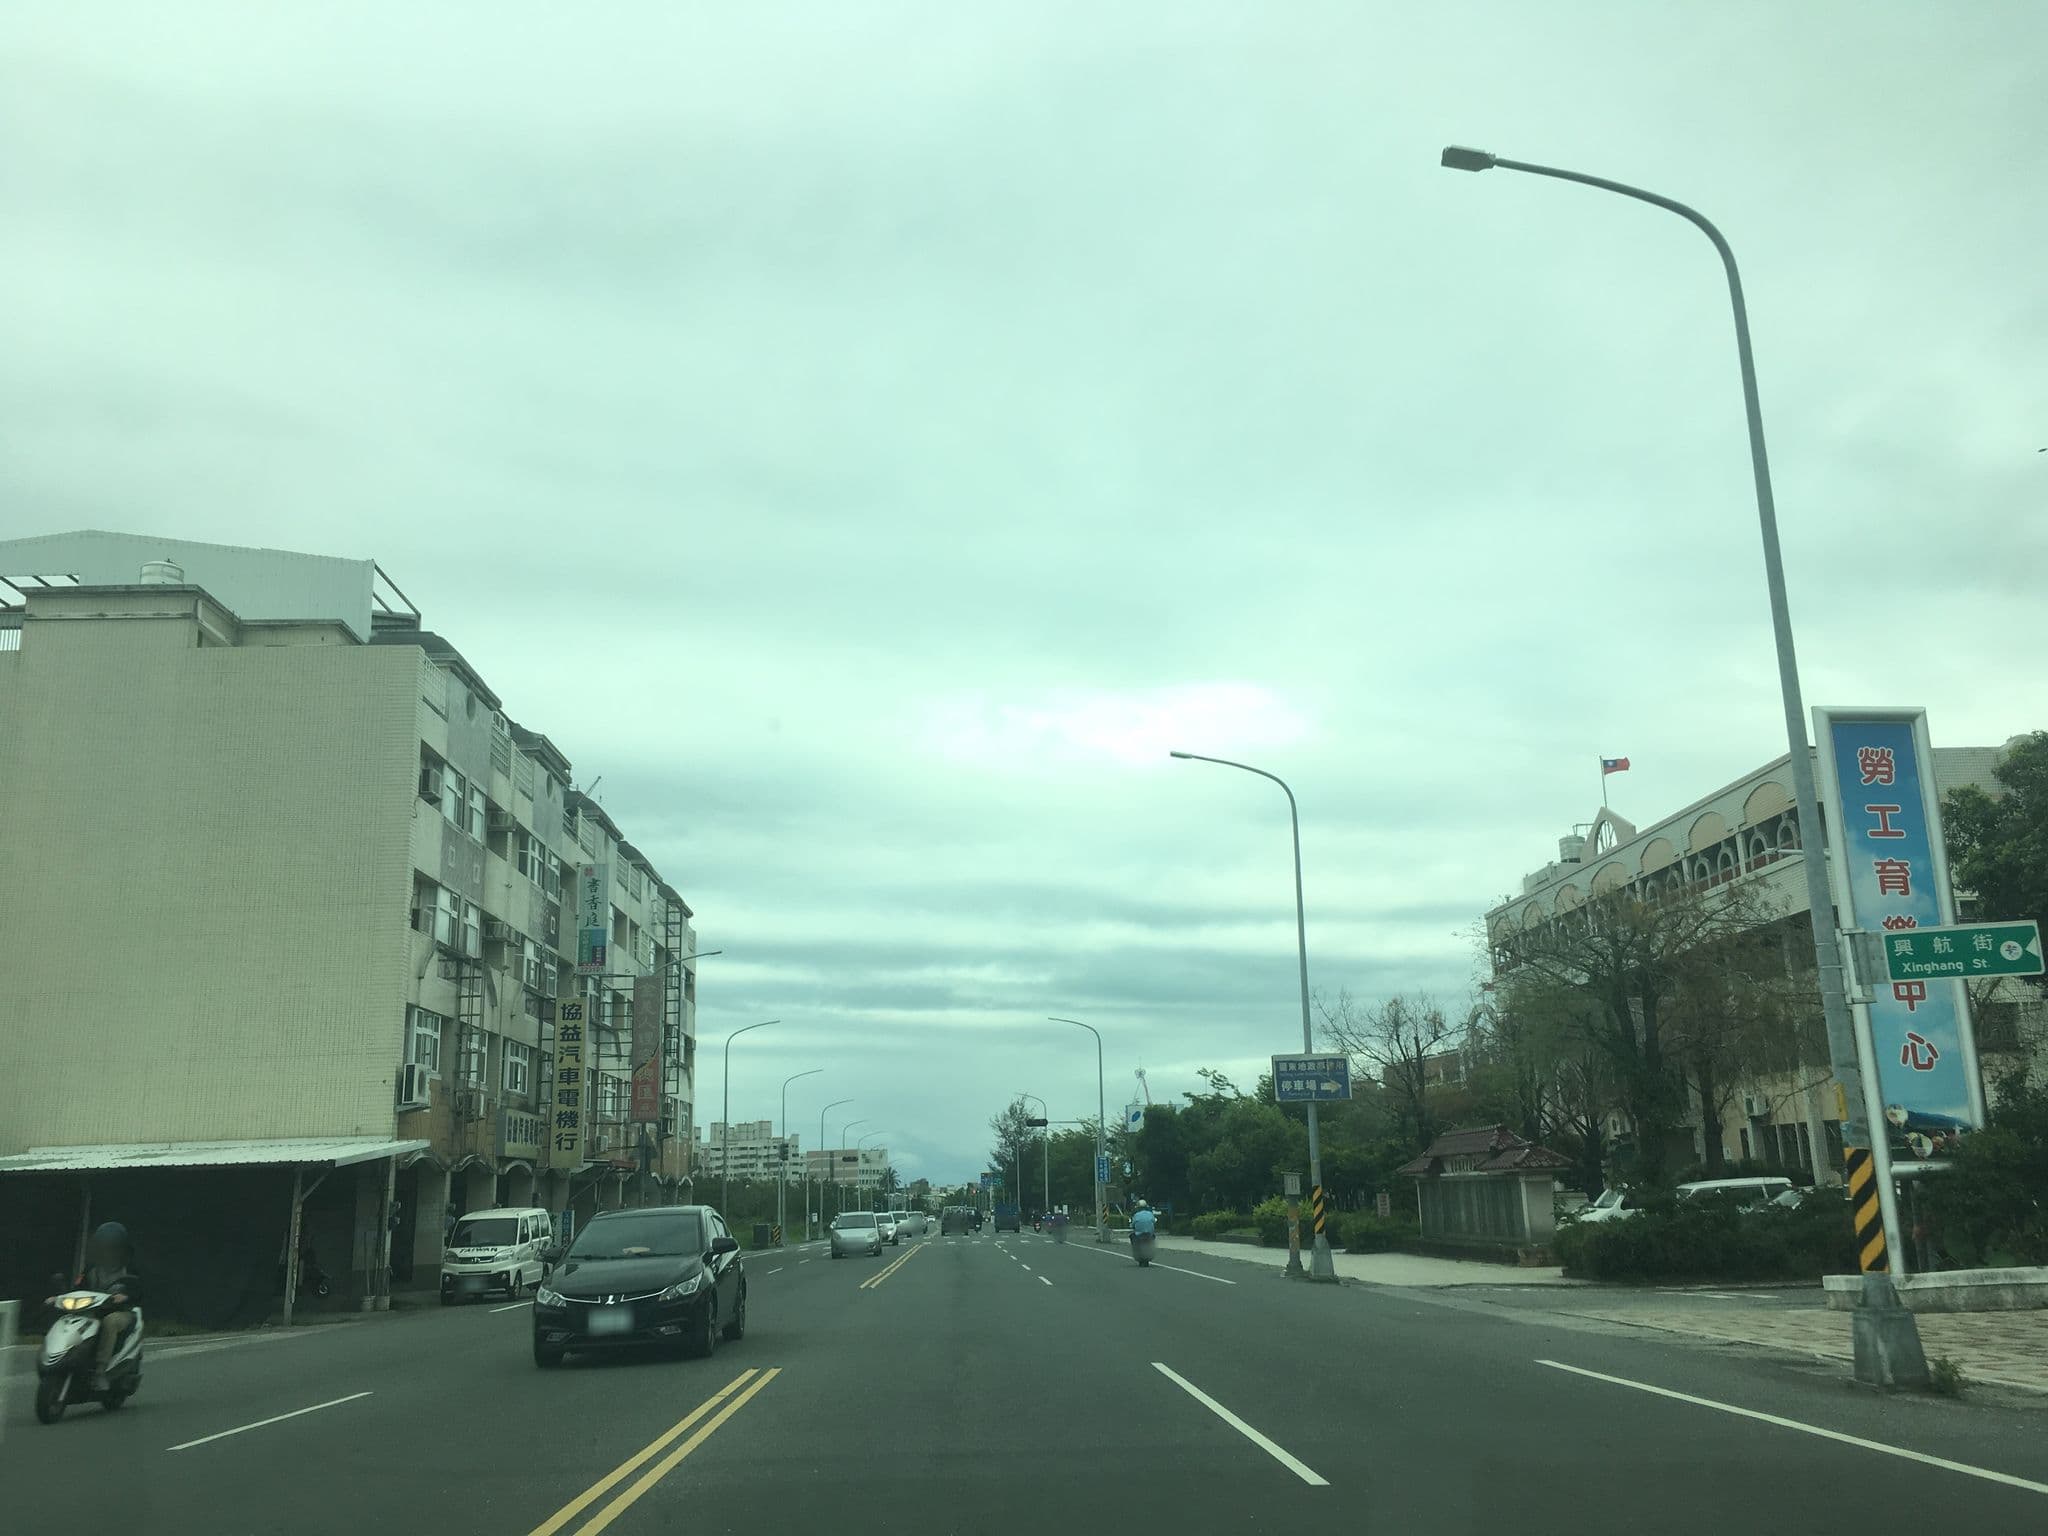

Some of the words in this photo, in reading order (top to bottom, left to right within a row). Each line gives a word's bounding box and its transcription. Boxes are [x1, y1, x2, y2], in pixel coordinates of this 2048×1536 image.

[1894, 934, 1993, 957] 興航街
[1902, 961, 1964, 975] Xinghang
[555, 1003, 582, 1152] 協益汽車電機行
[1281, 1079, 1317, 1092] 停車場
